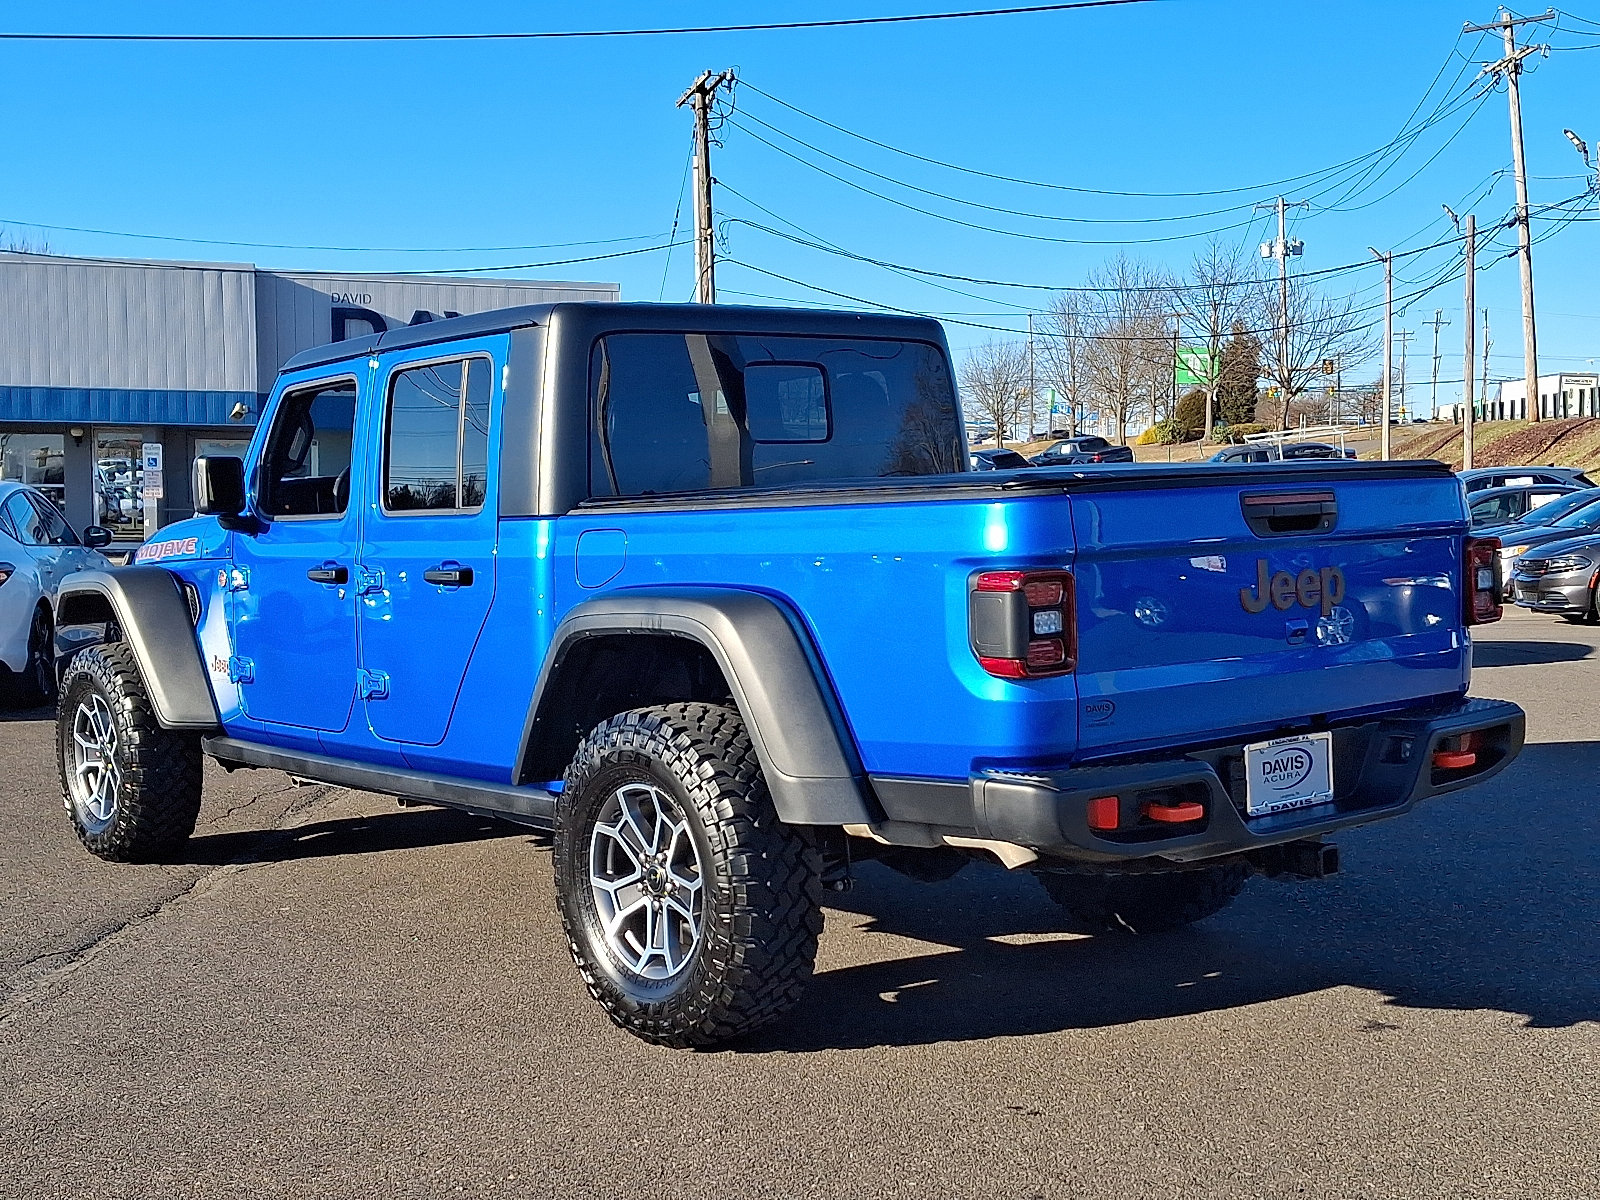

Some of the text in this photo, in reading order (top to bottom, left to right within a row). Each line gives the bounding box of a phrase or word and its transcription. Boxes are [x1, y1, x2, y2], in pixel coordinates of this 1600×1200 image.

[331, 292, 372, 305] DAVID
[136, 537, 198, 559] MOJAVE
[1240, 559, 1345, 618] Jeep
[1085, 703, 1110, 713] DAVIS
[1262, 754, 1304, 776] DAVIS
[1263, 771, 1301, 784] ACURA
[1270, 798, 1313, 812] DAVIS
